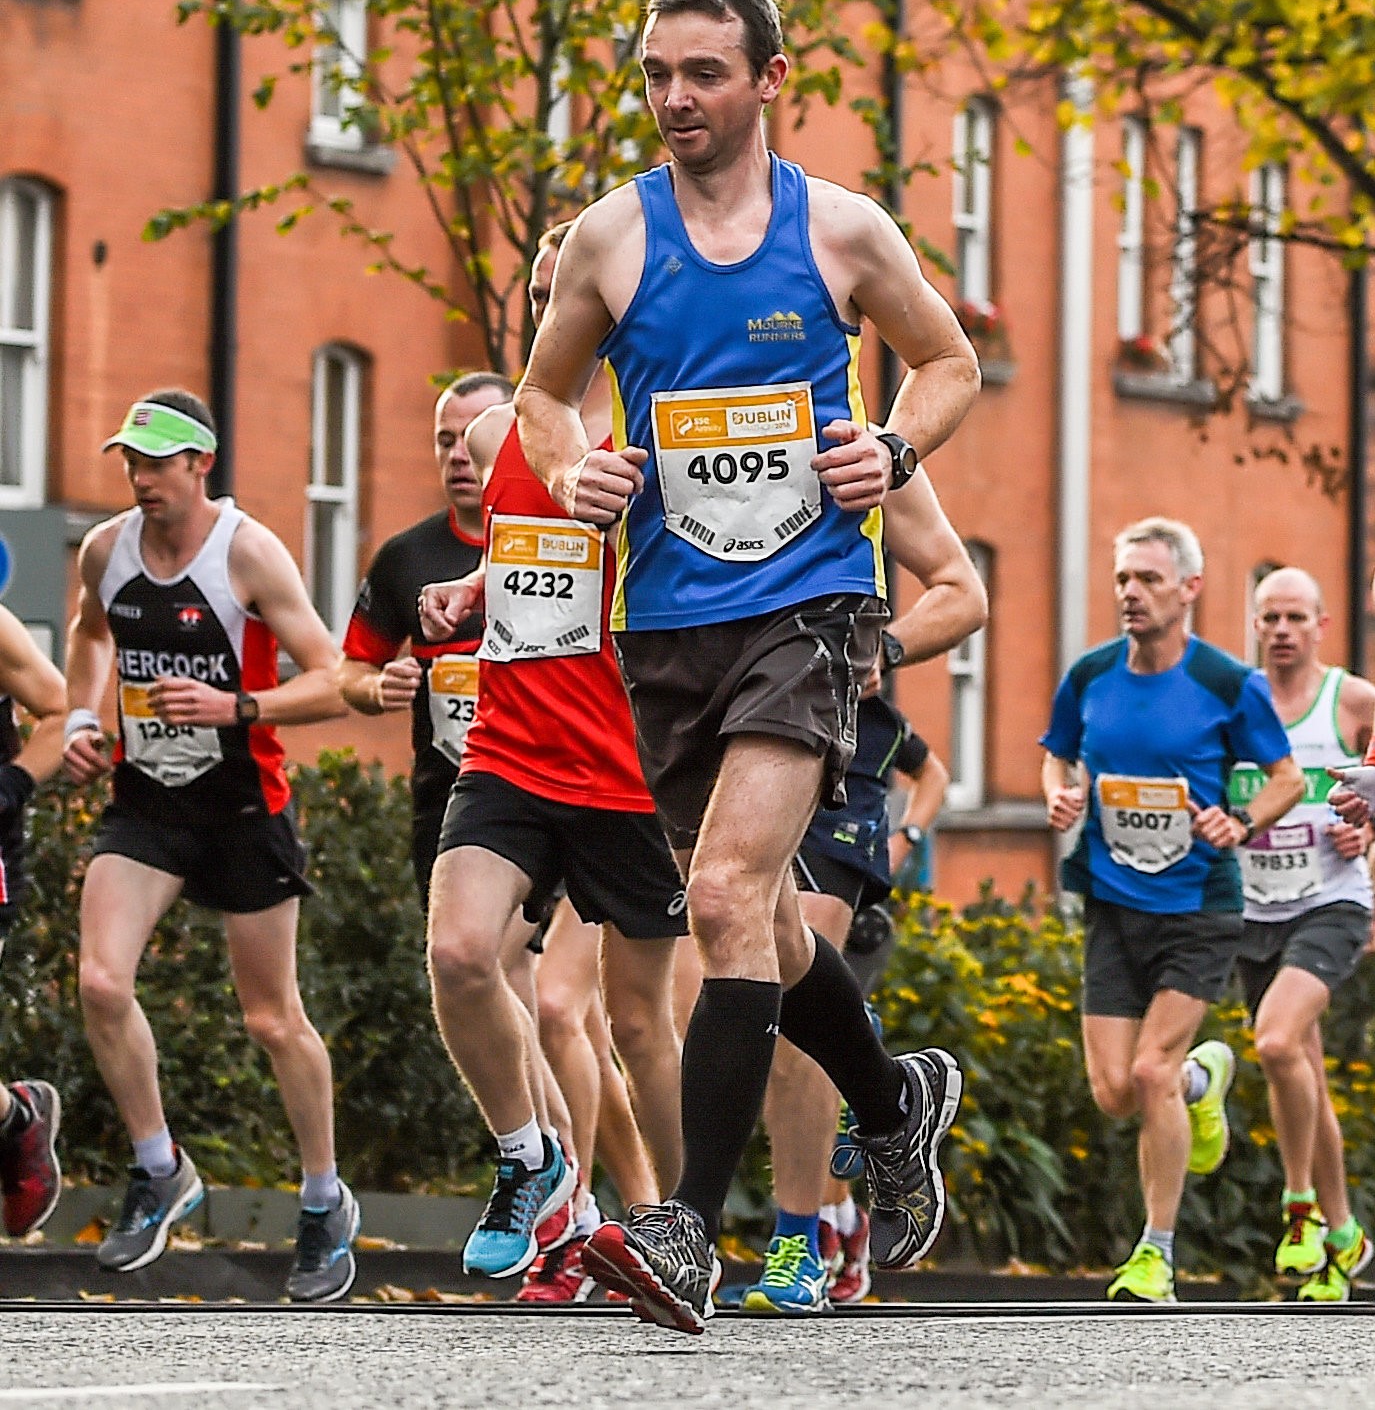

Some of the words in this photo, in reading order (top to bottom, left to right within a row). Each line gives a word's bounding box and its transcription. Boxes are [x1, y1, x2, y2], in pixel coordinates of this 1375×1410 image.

[732, 409, 791, 425] DUBLIN
[687, 449, 790, 485] 4095
[736, 540, 765, 552] asics
[503, 570, 574, 600] 4232
[1116, 810, 1173, 831] 5007
